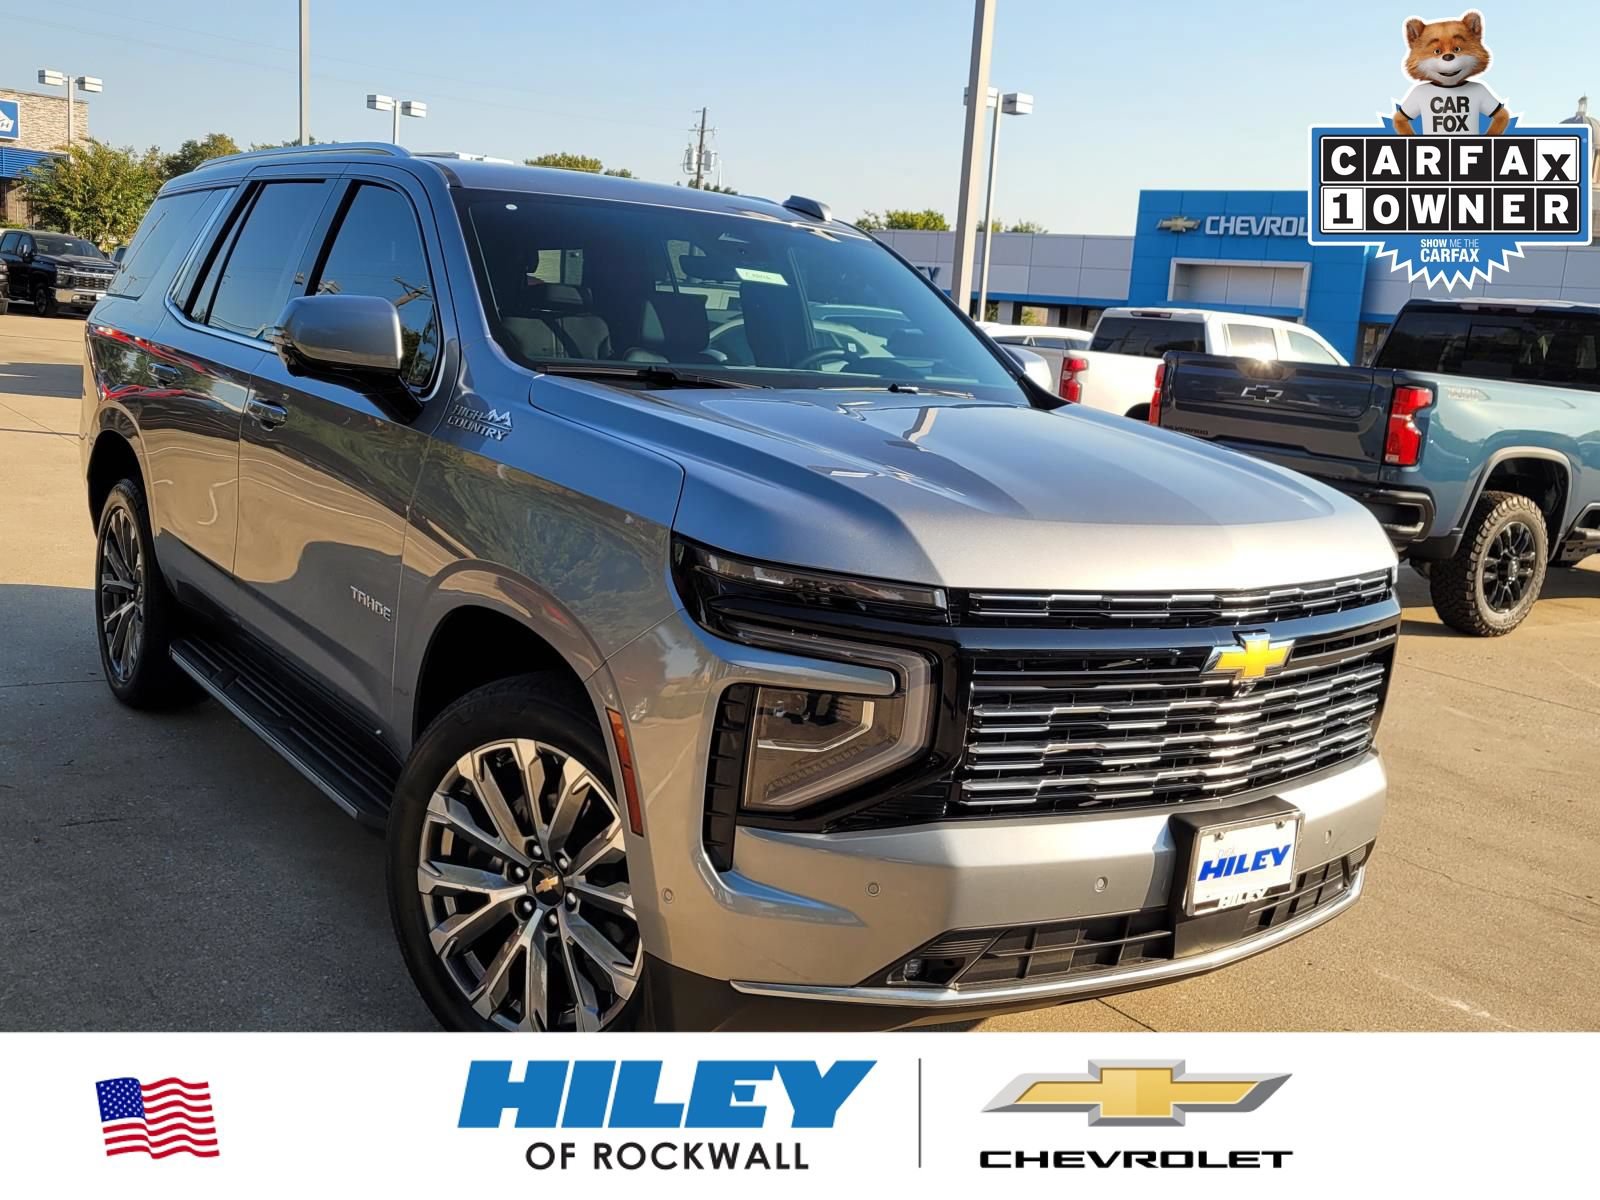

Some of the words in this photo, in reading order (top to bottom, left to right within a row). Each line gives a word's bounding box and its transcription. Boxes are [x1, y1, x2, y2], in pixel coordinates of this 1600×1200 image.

[447, 415, 507, 440] COUNTRY
[452, 404, 482, 420] HIGH
[350, 585, 391, 622] TAHOE
[1198, 844, 1292, 882] HILEY
